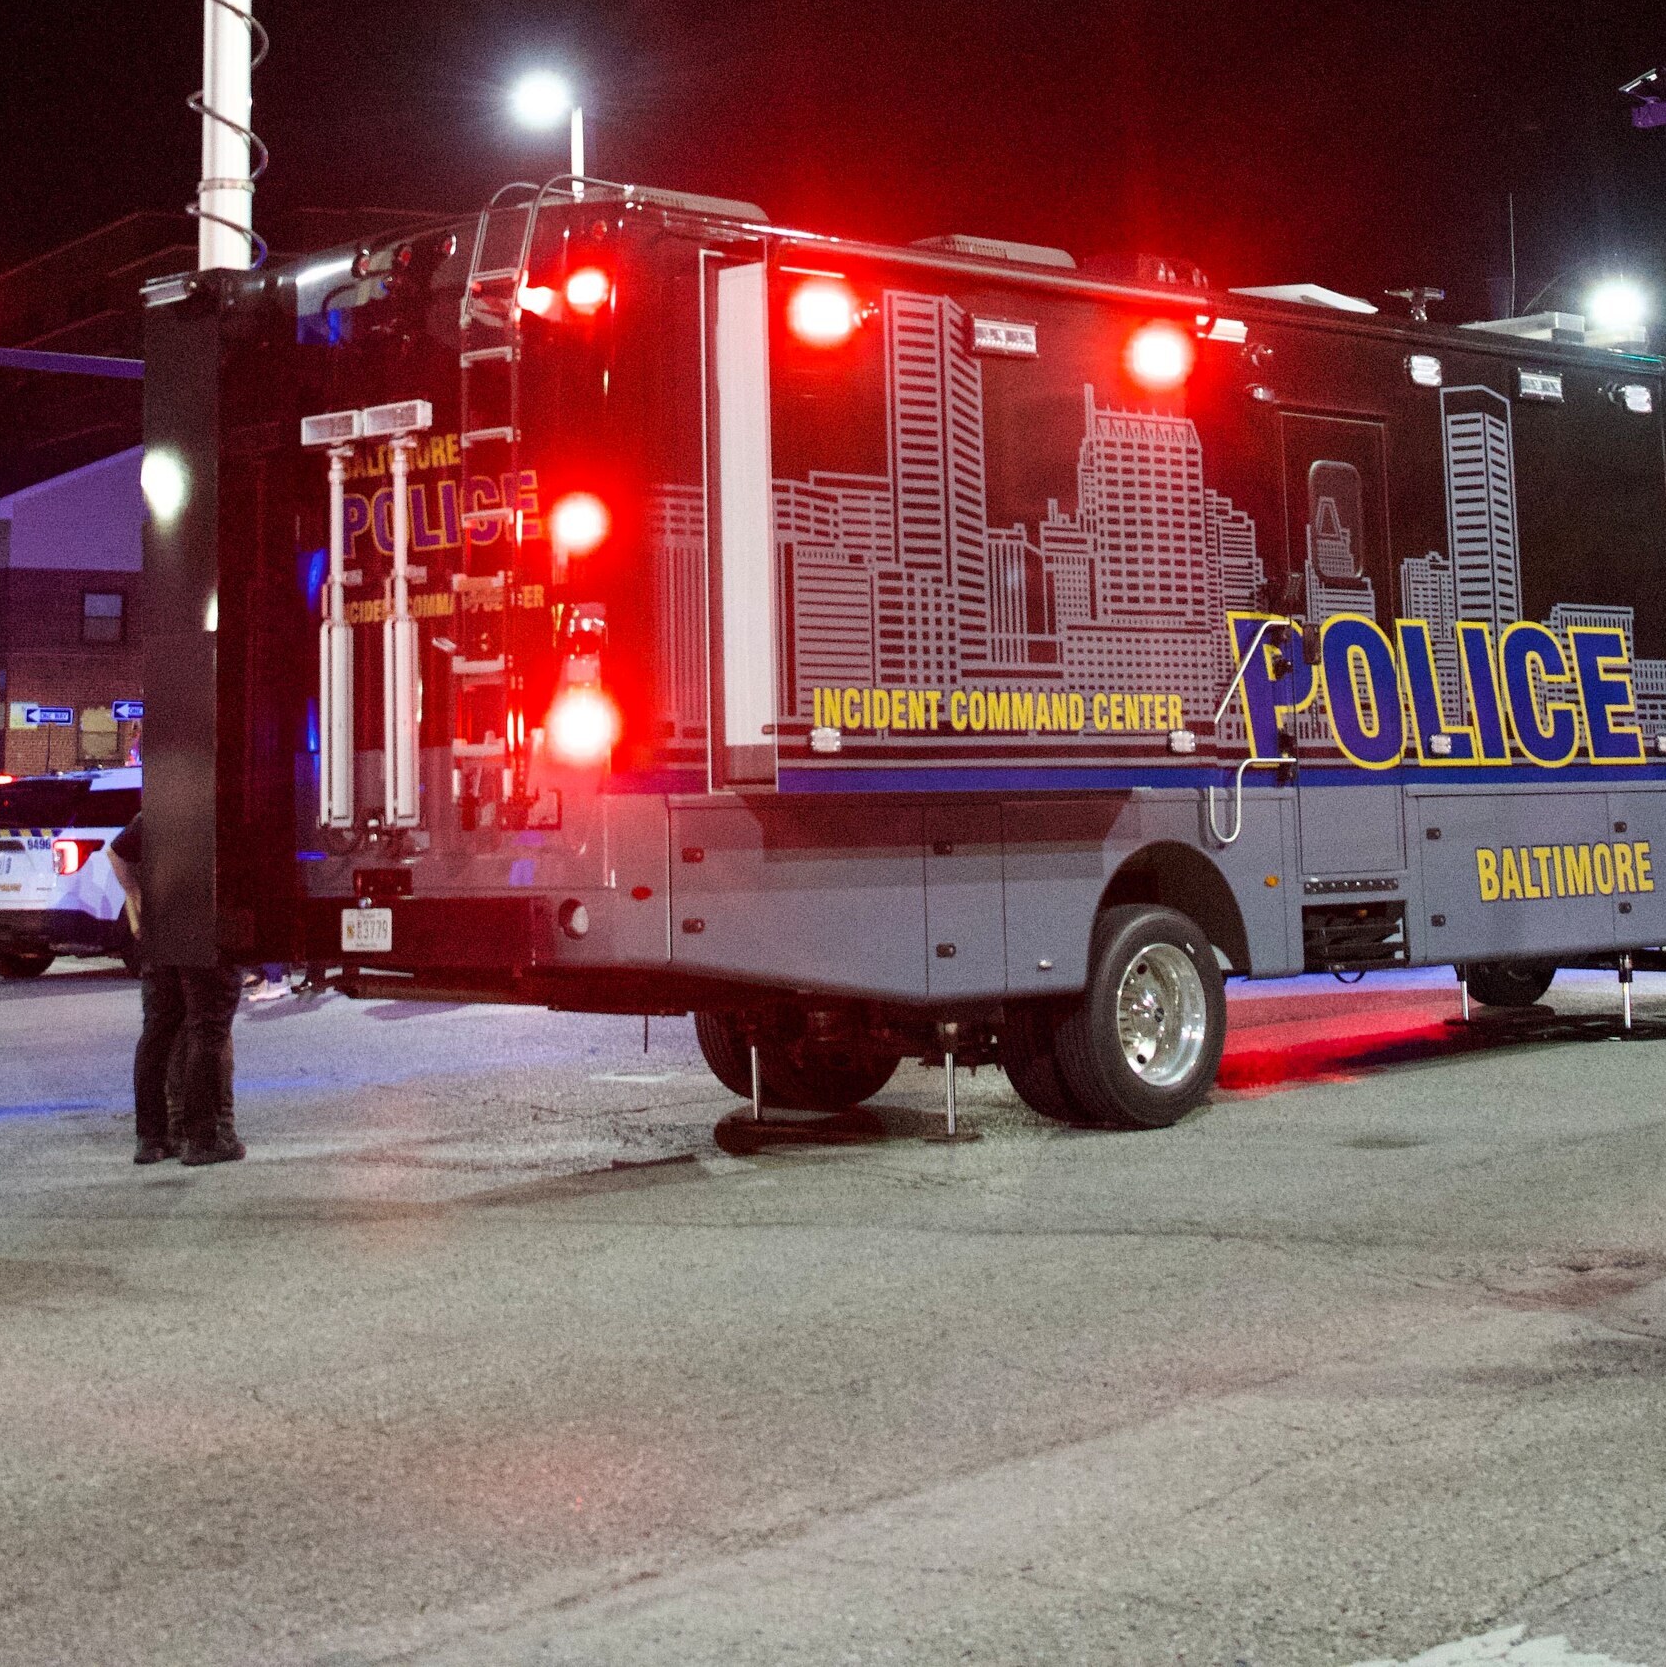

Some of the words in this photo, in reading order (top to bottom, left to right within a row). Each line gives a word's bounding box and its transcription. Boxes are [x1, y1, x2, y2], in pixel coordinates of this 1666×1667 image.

[342, 469, 542, 559] POLICE
[813, 686, 942, 730] INCIDENT
[950, 690, 1085, 731] COMMAND
[1092, 692, 1184, 732] CENTER
[1227, 610, 1648, 771] POLICE
[1475, 840, 1655, 903] BALTIMORE
